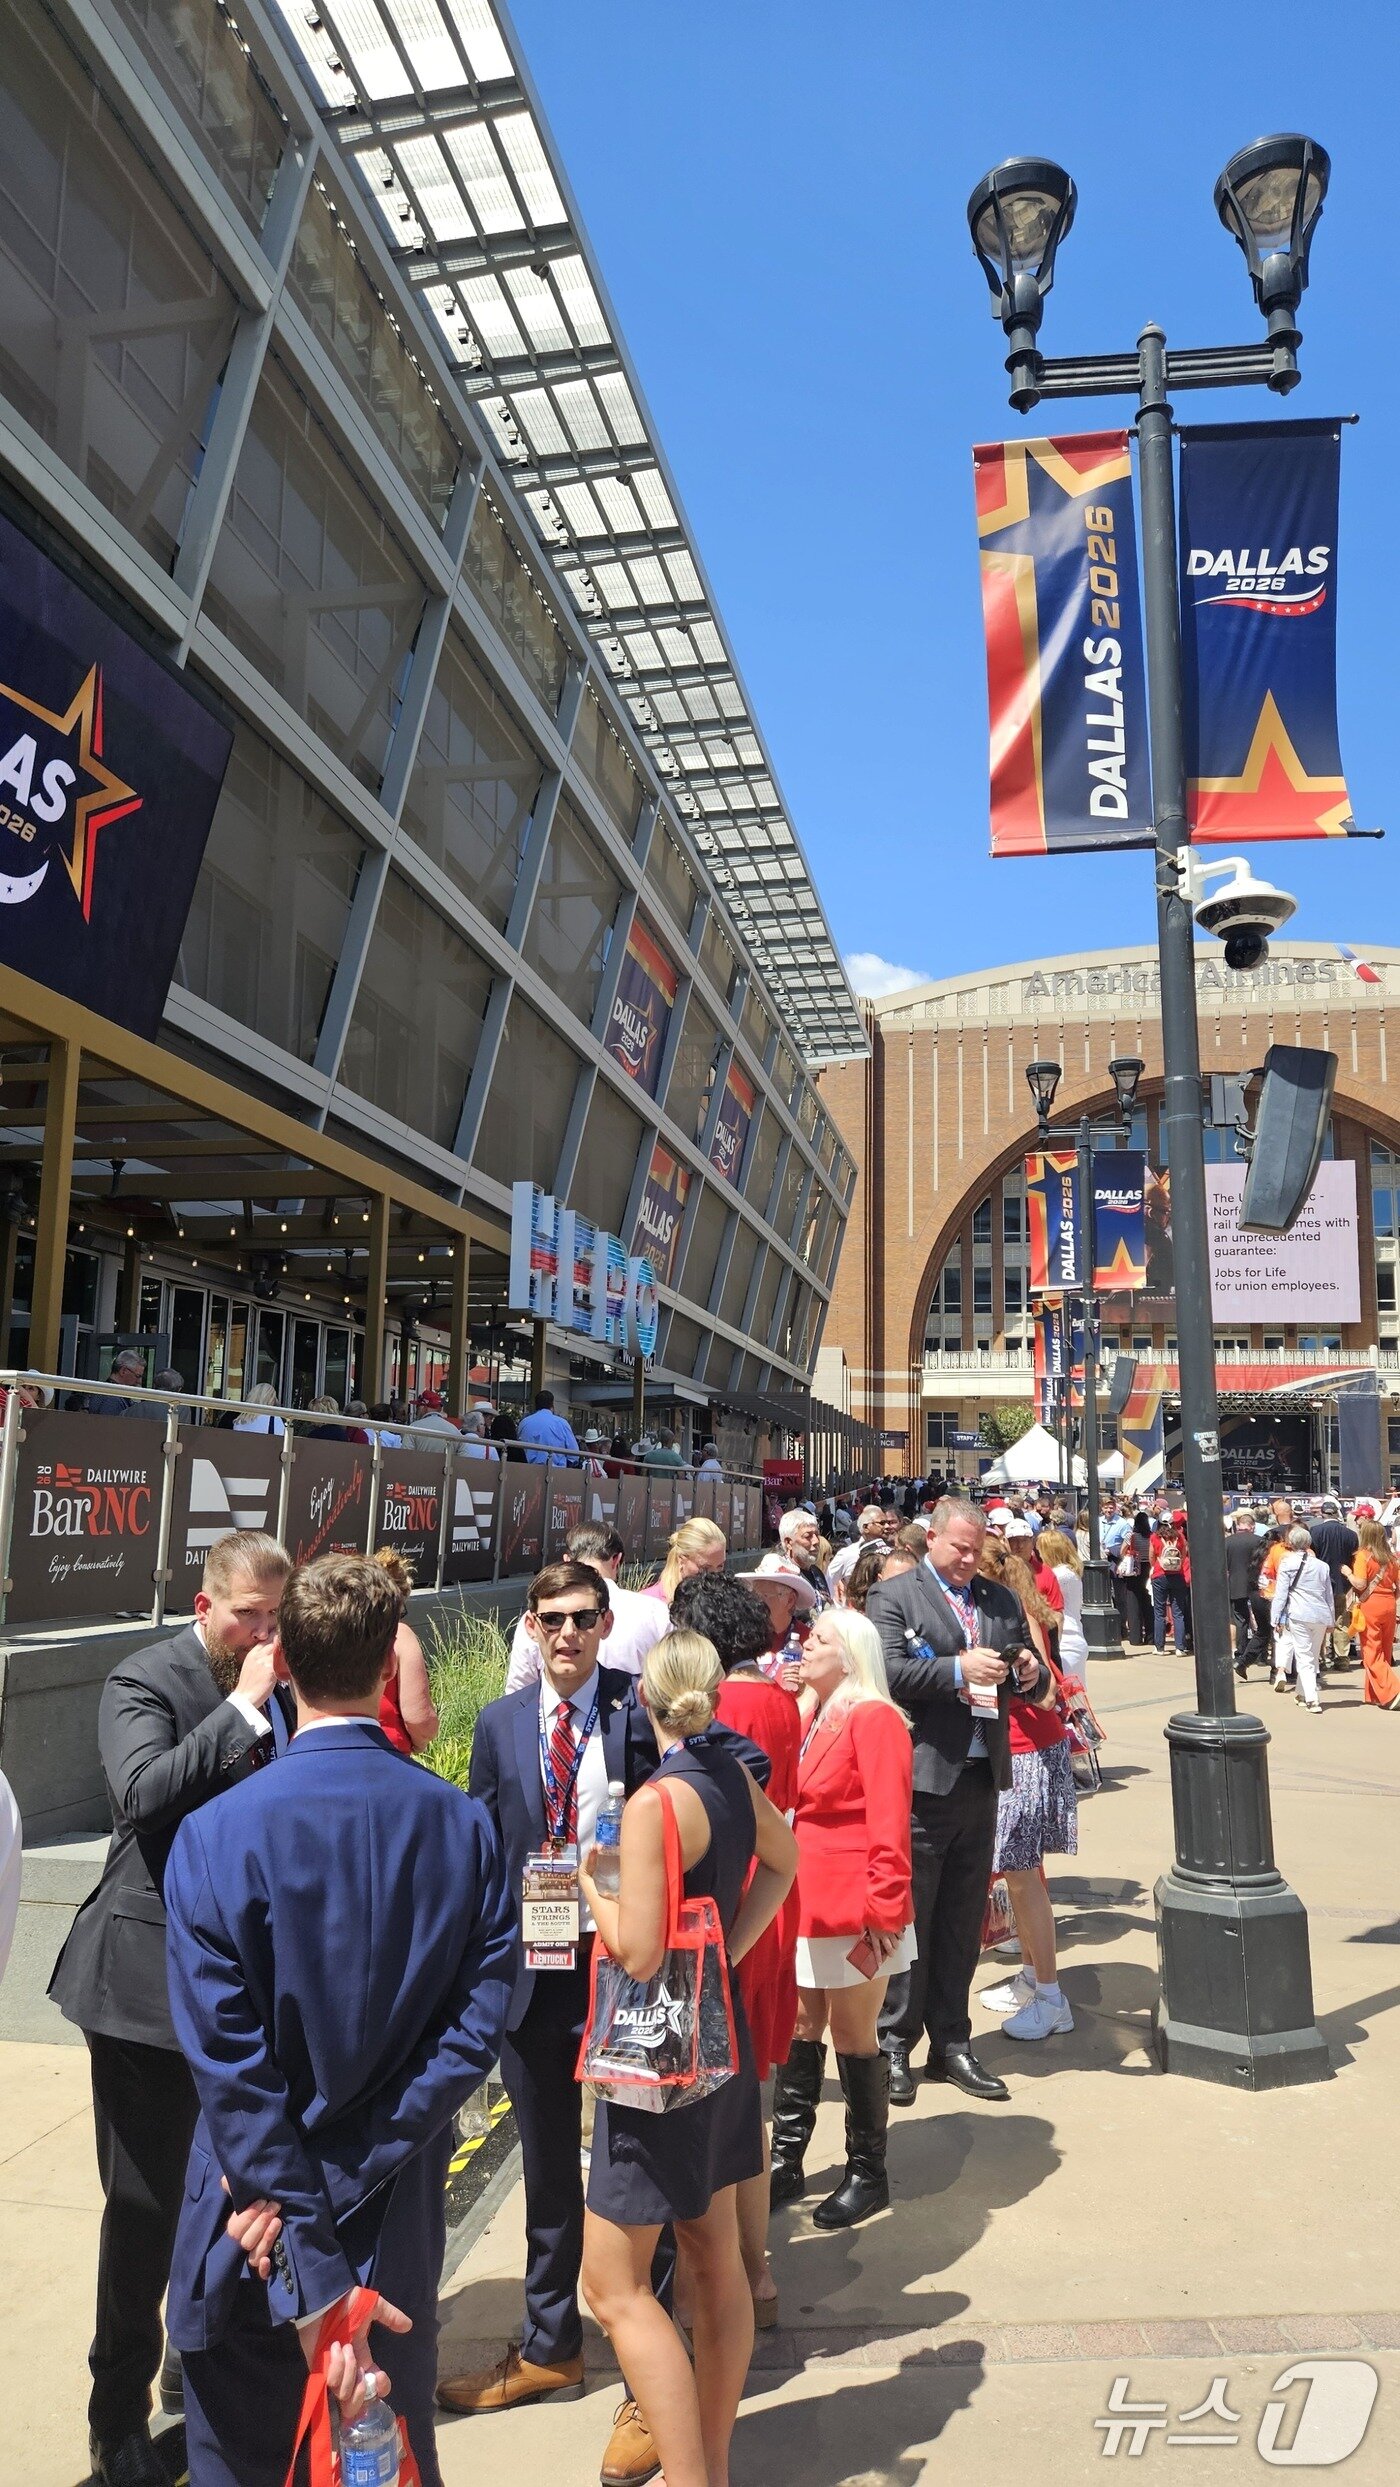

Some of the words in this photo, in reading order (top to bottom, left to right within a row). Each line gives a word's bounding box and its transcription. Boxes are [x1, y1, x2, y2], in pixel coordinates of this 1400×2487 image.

[1084, 504, 1121, 630] 2026
[1187, 546, 1330, 576] DALLAS
[1225, 577, 1286, 591] 2026
[1083, 636, 1129, 820] DALLAS
[613, 996, 649, 1048] DALLAS
[715, 1120, 736, 1155] DALLAS
[1061, 1176, 1074, 1219] 2026
[1094, 1189, 1143, 1200] DALLAS
[1213, 1193, 1235, 1203] The
[1213, 1221, 1231, 1230] rail
[1325, 1218, 1350, 1228] with
[1214, 1234, 1228, 1243] an
[1061, 1220, 1076, 1281] DALLAS
[1214, 1246, 1277, 1258] guarantee:
[509, 1181, 660, 1358] HERO
[1214, 1267, 1242, 1278] Jobs
[1245, 1267, 1262, 1277] for
[1265, 1267, 1287, 1277] Life
[1215, 1281, 1231, 1291] for
[1235, 1281, 1268, 1291] union
[1271, 1280, 1340, 1292] employees.
[1051, 1338, 1062, 1374] DALLAS
[36, 1475, 51, 1486] 26
[37, 1465, 52, 1475] 20
[86, 1468, 148, 1484] DAILYWIRE
[408, 1485, 437, 1496] DAILYWIRE
[310, 1477, 335, 1528] Enjoy
[451, 1541, 480, 1554] DAILYWIRE
[48, 1553, 72, 1584] Enjoy
[73, 1552, 126, 1578] Conservatively
[585, 1705, 598, 1733] DALLAS
[531, 1905, 571, 1915] STARS
[532, 1952, 569, 1965] KENTUCKY
